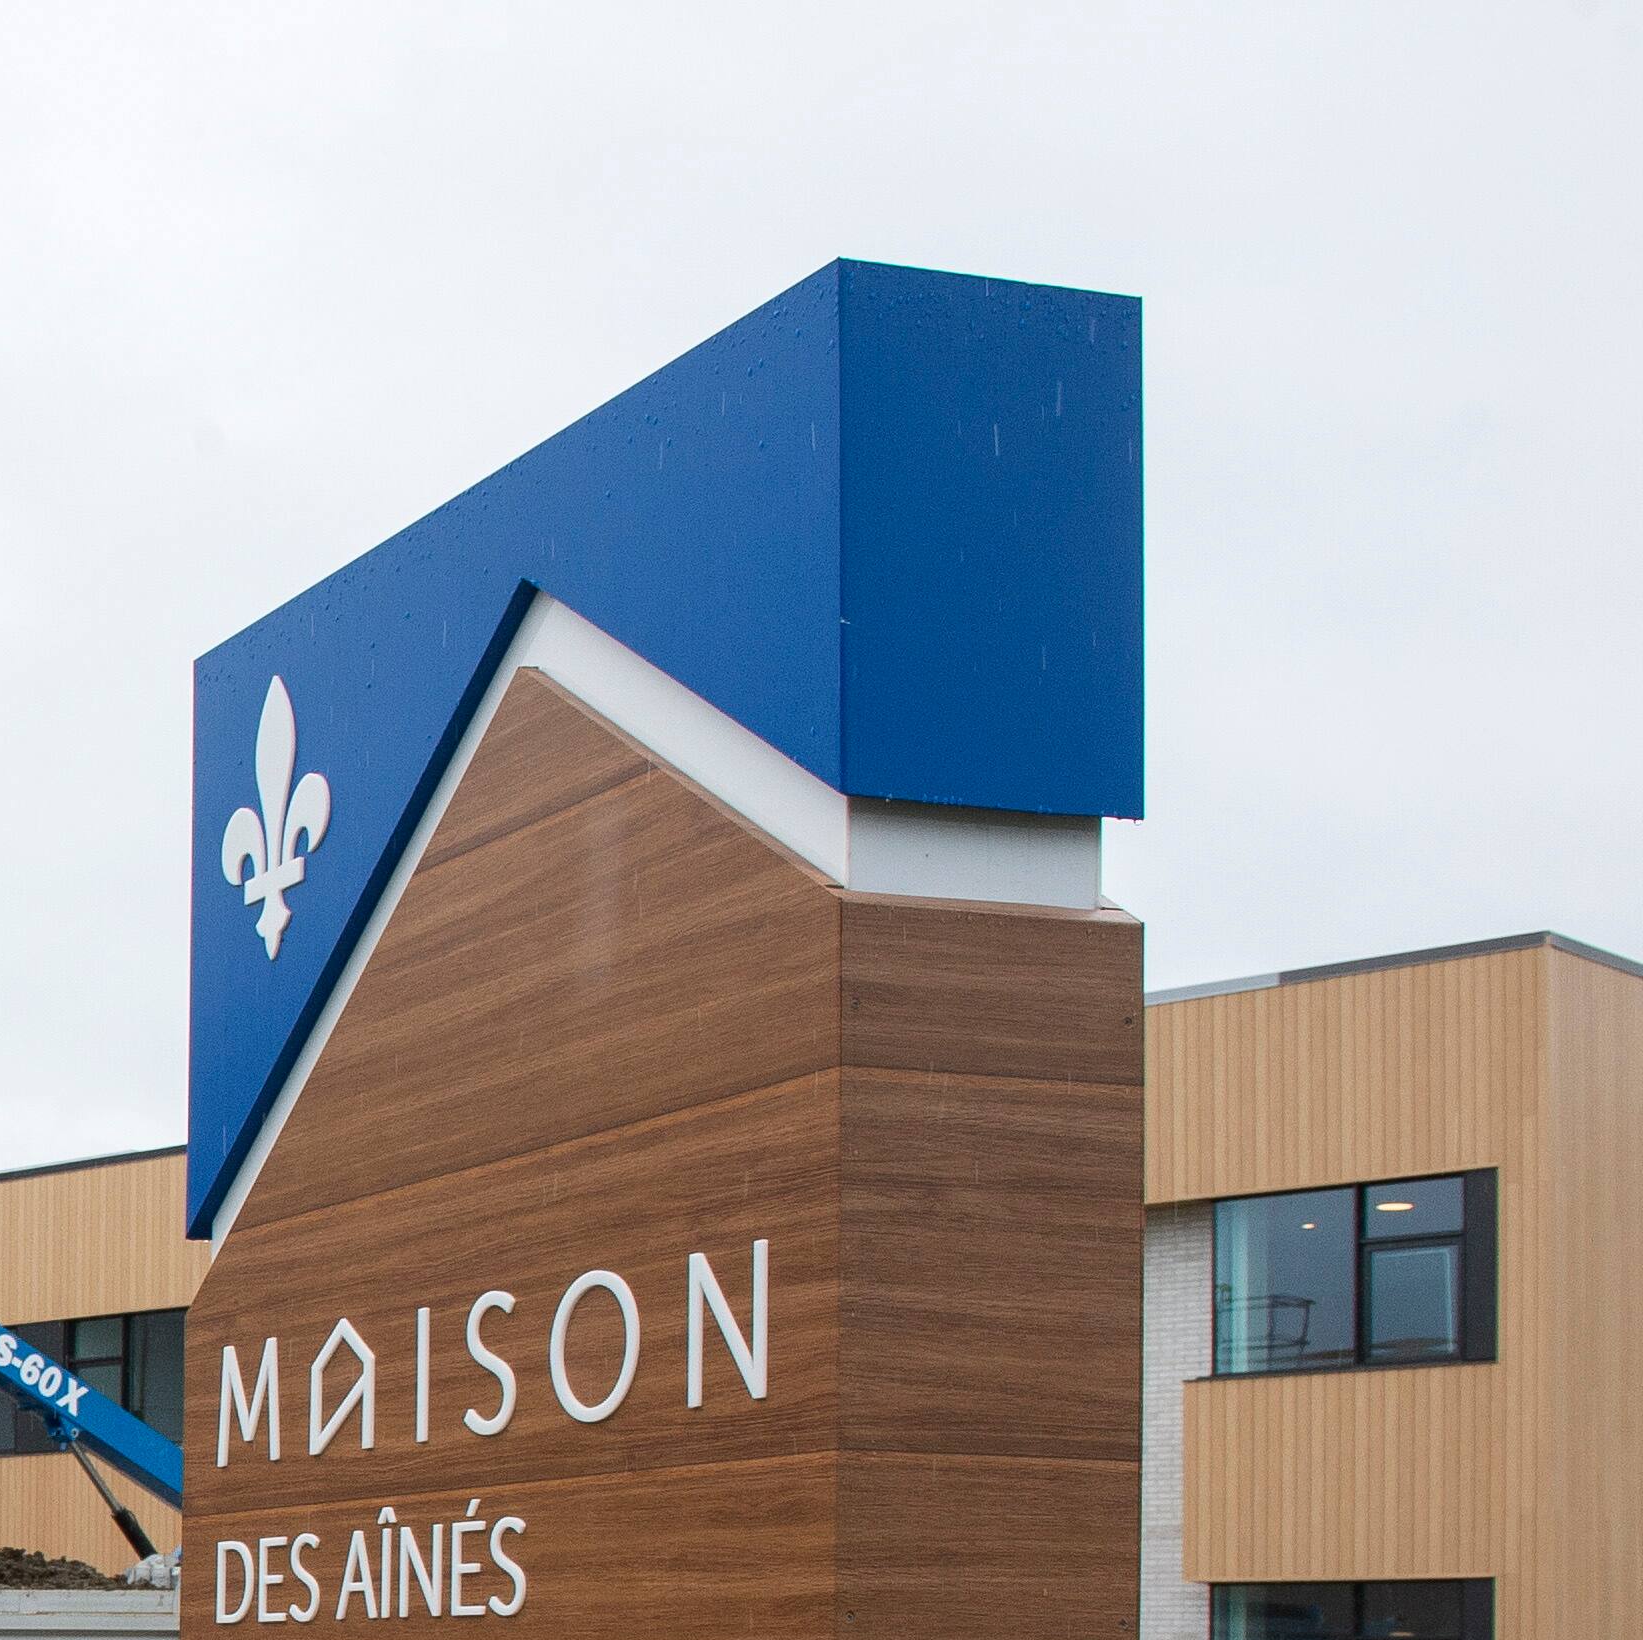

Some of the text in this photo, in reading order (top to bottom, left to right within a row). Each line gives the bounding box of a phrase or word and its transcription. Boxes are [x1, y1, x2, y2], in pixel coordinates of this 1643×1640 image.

[216, 1239, 769, 1468] MAISON
[216, 1499, 527, 1624] DES AÎNÉS
